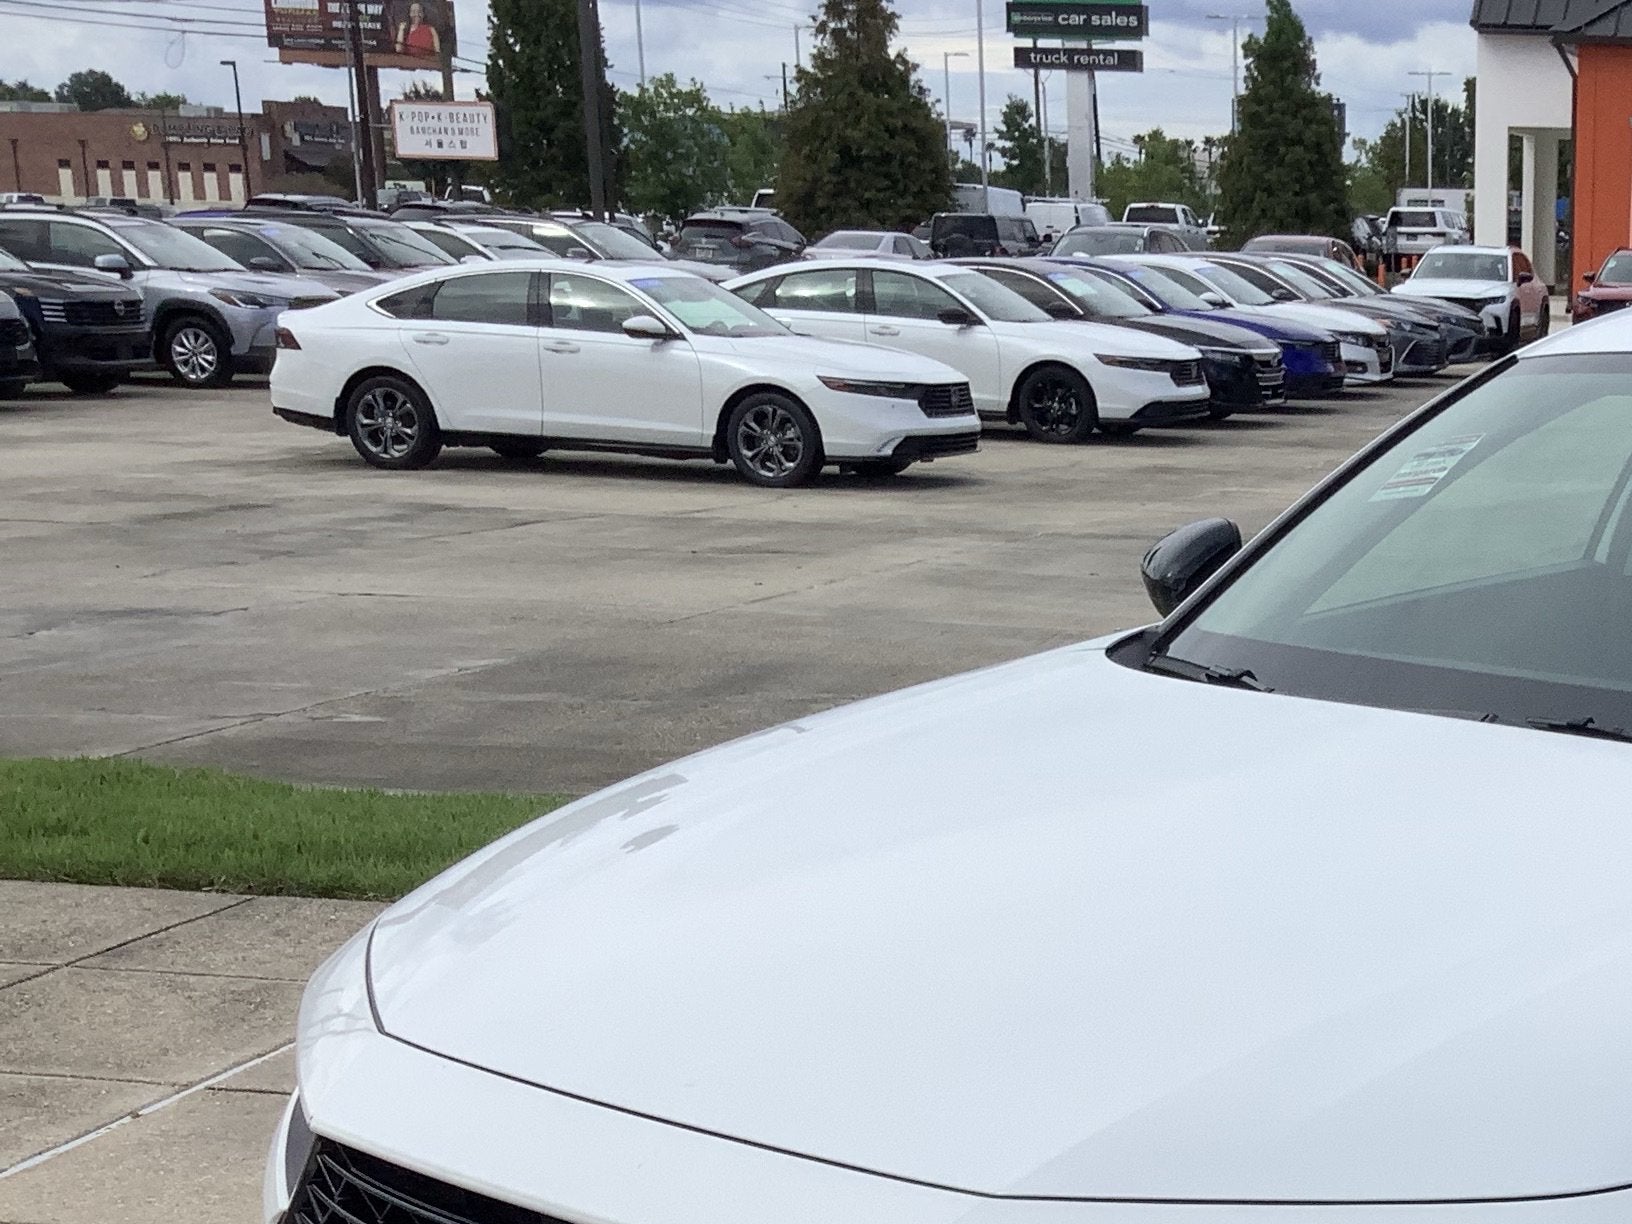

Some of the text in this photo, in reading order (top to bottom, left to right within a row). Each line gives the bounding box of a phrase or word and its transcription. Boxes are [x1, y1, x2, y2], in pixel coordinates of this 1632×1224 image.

[1058, 13, 1087, 25] car
[1091, 10, 1138, 27] sales
[1030, 50, 1118, 65] truck rental
